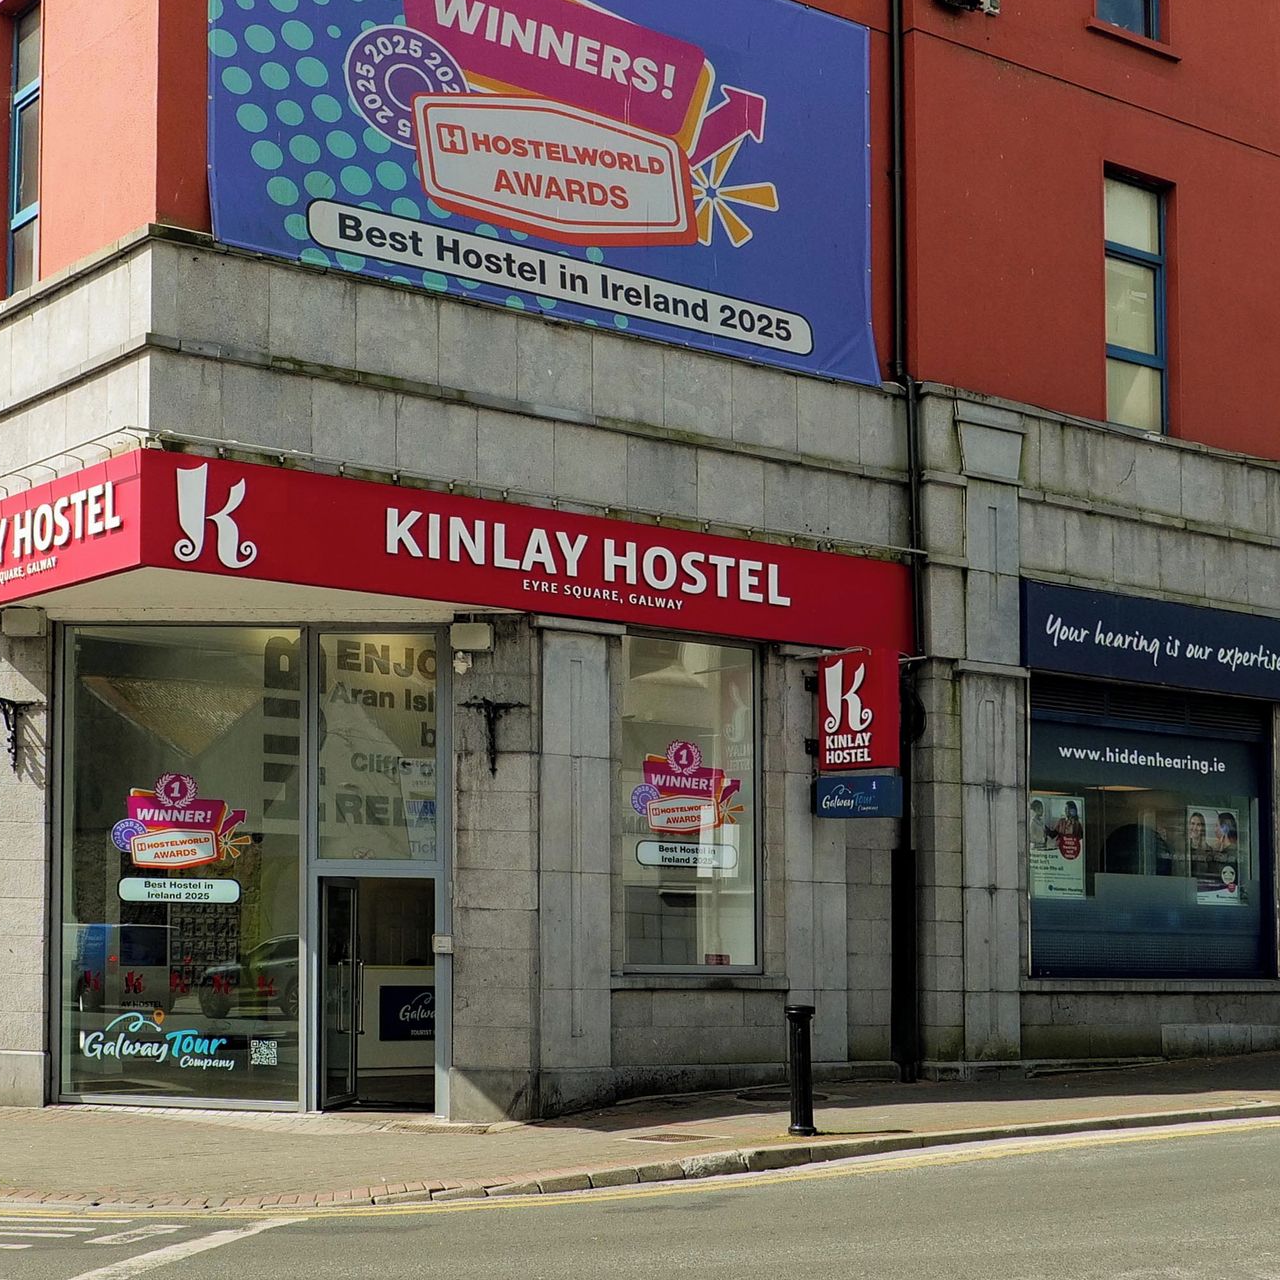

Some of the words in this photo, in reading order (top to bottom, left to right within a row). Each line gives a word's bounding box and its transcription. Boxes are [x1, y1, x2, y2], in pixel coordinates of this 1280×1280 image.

[363, 34, 423, 64] 2025
[471, 131, 665, 175] HOSTELWORLD
[493, 168, 630, 210] AWARDS
[337, 211, 424, 258] Best
[435, 233, 547, 286] Hostel
[558, 264, 589, 296] in
[600, 273, 710, 324] Ireland
[718, 304, 793, 343] 2025
[11, 480, 122, 558] HOSTEL
[26, 555, 58, 576] GALWAY
[386, 507, 588, 577] KINLAY
[603, 538, 791, 607] HOSTEL
[522, 579, 558, 594] EYRE
[563, 584, 624, 604] SQUARE,
[628, 593, 684, 611] GALWAY
[1045, 613, 1090, 647] Your
[1095, 620, 1160, 667] hearing
[1166, 635, 1181, 658] is
[1186, 643, 1213, 661] our
[329, 682, 395, 708] Aran
[825, 732, 872, 749] KINLAY
[826, 748, 872, 764] HOSTEL
[1059, 745, 1226, 774] www.hiddenhearing.ie
[170, 781, 181, 797] 1
[651, 773, 714, 791] WINNER!
[822, 794, 854, 810] Galway
[136, 808, 212, 823] WINNER!
[147, 837, 210, 849] HOSTELWORLD
[658, 845, 678, 853] Best
[153, 848, 197, 859] AWARDS
[661, 856, 691, 864] Ireland
[144, 880, 166, 889] Best
[170, 881, 201, 890] Hostel
[204, 881, 213, 890] in
[147, 891, 182, 900] Ireland
[185, 892, 210, 900] 2025
[83, 1031, 169, 1062] Galway
[166, 1029, 227, 1057] Tour
[179, 1055, 235, 1070] Company
